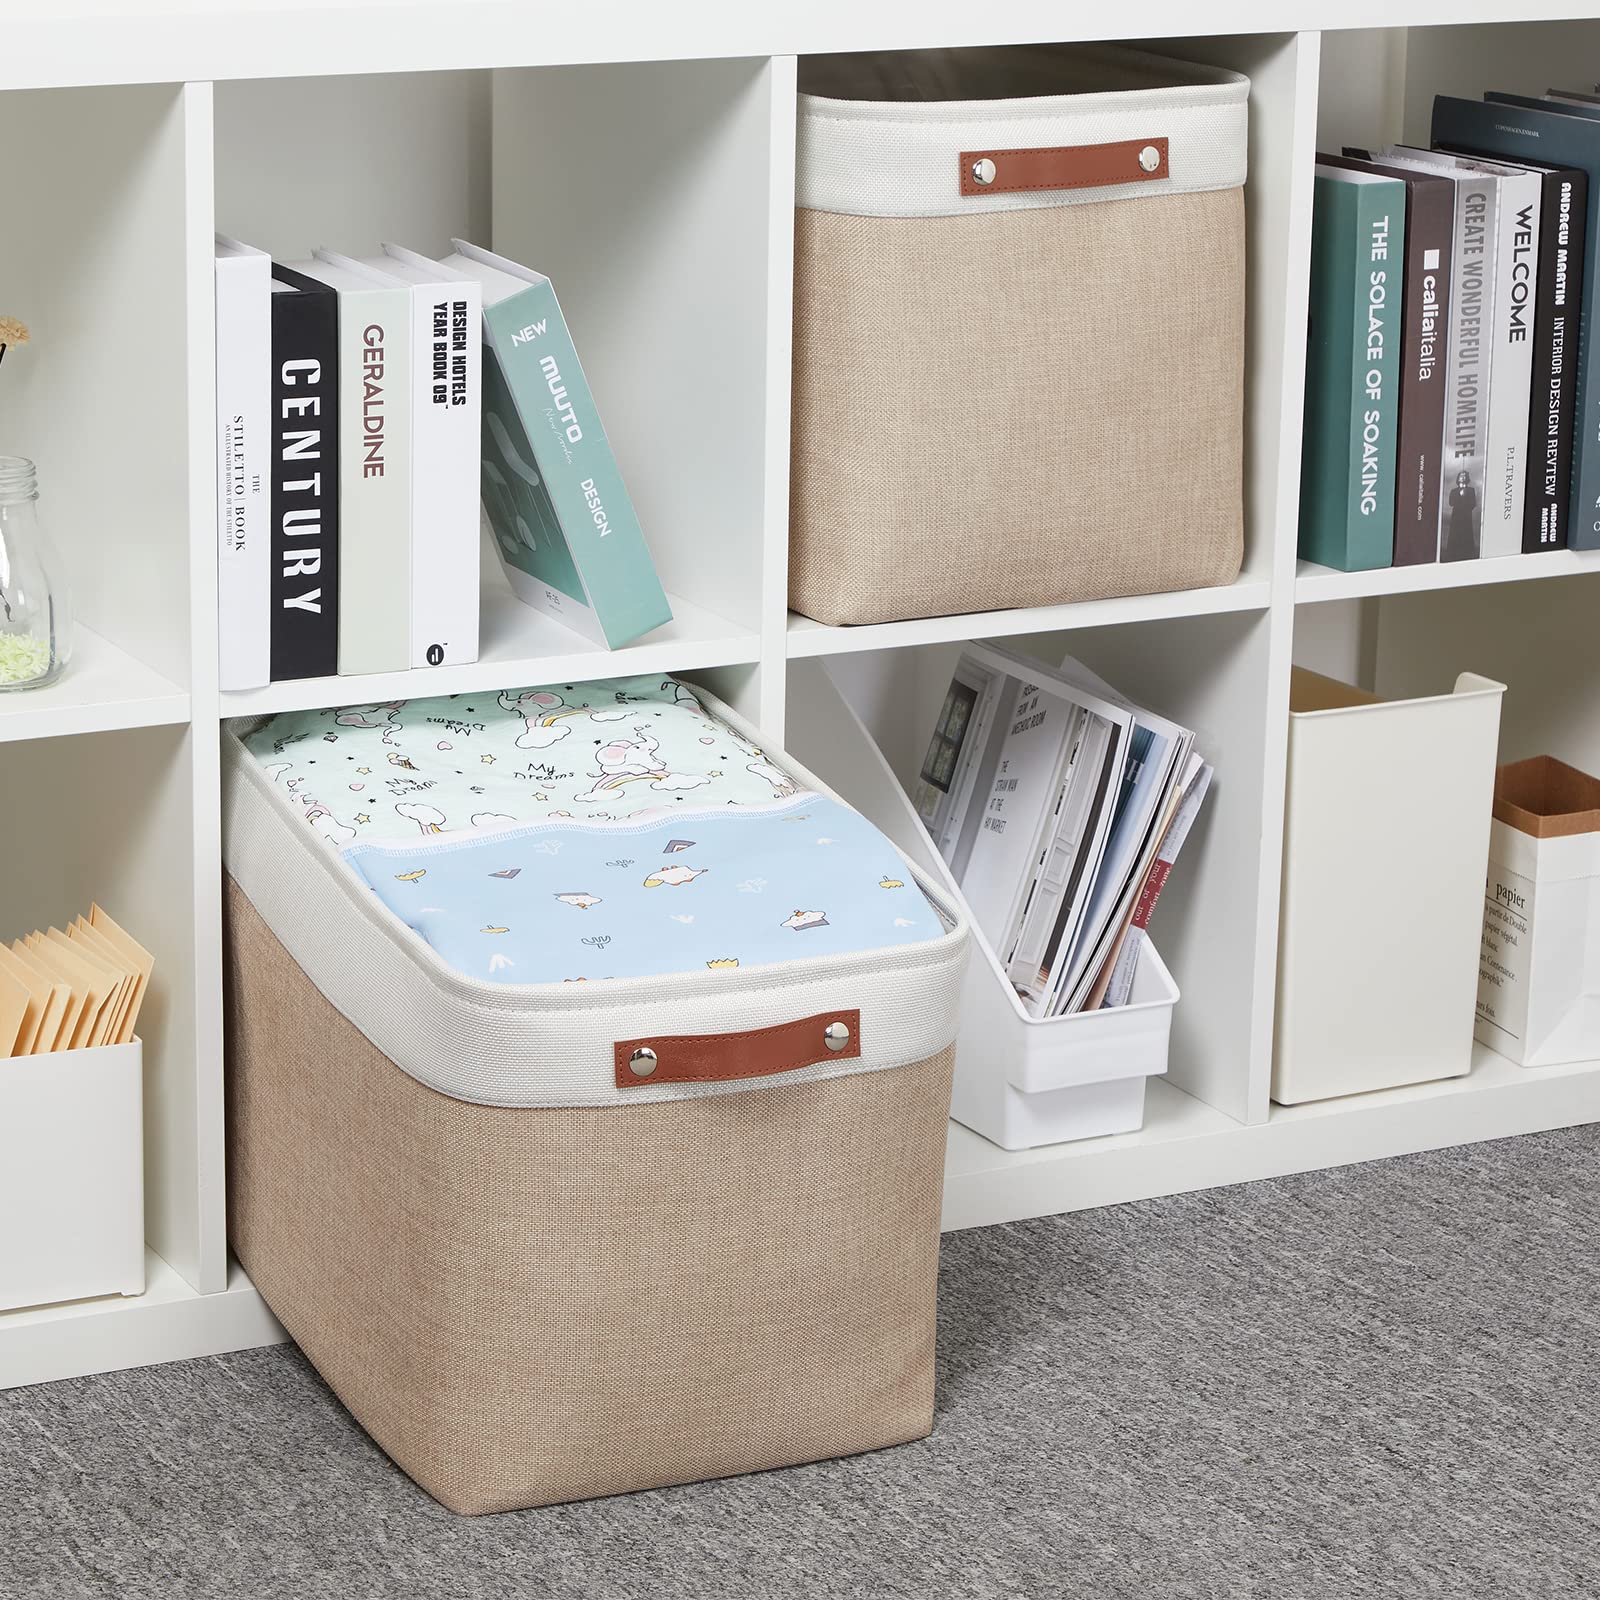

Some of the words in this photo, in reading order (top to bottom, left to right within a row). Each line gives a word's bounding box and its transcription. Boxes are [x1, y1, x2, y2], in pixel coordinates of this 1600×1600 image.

[1371, 215, 1388, 261] THE
[1464, 193, 1486, 255] CREATE
[1558, 182, 1572, 245] ANDREW
[1508, 204, 1533, 344] WELCOME
[1555, 249, 1568, 305] MARTIN
[433, 302, 448, 338] YEAR
[452, 301, 467, 351] DESIGN
[511, 318, 547, 347] NEW
[1367, 271, 1386, 360] SOLACE
[1419, 275, 1439, 381] caliaitalia
[1459, 260, 1482, 368] WONDERFUL
[433, 342, 448, 380] BOOK
[1551, 317, 1565, 375] INTERIOR
[363, 324, 384, 479] GERALDINE
[452, 355, 466, 406] HOTELS
[1365, 369, 1382, 400] OF
[1548, 378, 1561, 435] DESIGN
[1455, 373, 1478, 459] HOMELIFE
[234, 415, 245, 495] STILETTO
[1360, 410, 1380, 516] SOAKING
[252, 474, 260, 494] THE
[281, 358, 321, 614] CENTURY
[580, 478, 612, 537] DESIGN
[235, 506, 246, 551] BOOK
[1540, 507, 1548, 543] MARTIN
[513, 771, 575, 781] Dreams
[528, 763, 556, 776] My
[1135, 906, 1143, 921] out
[1143, 889, 1150, 899] of
[1150, 864, 1161, 884] your
[1496, 883, 1526, 908] papier
